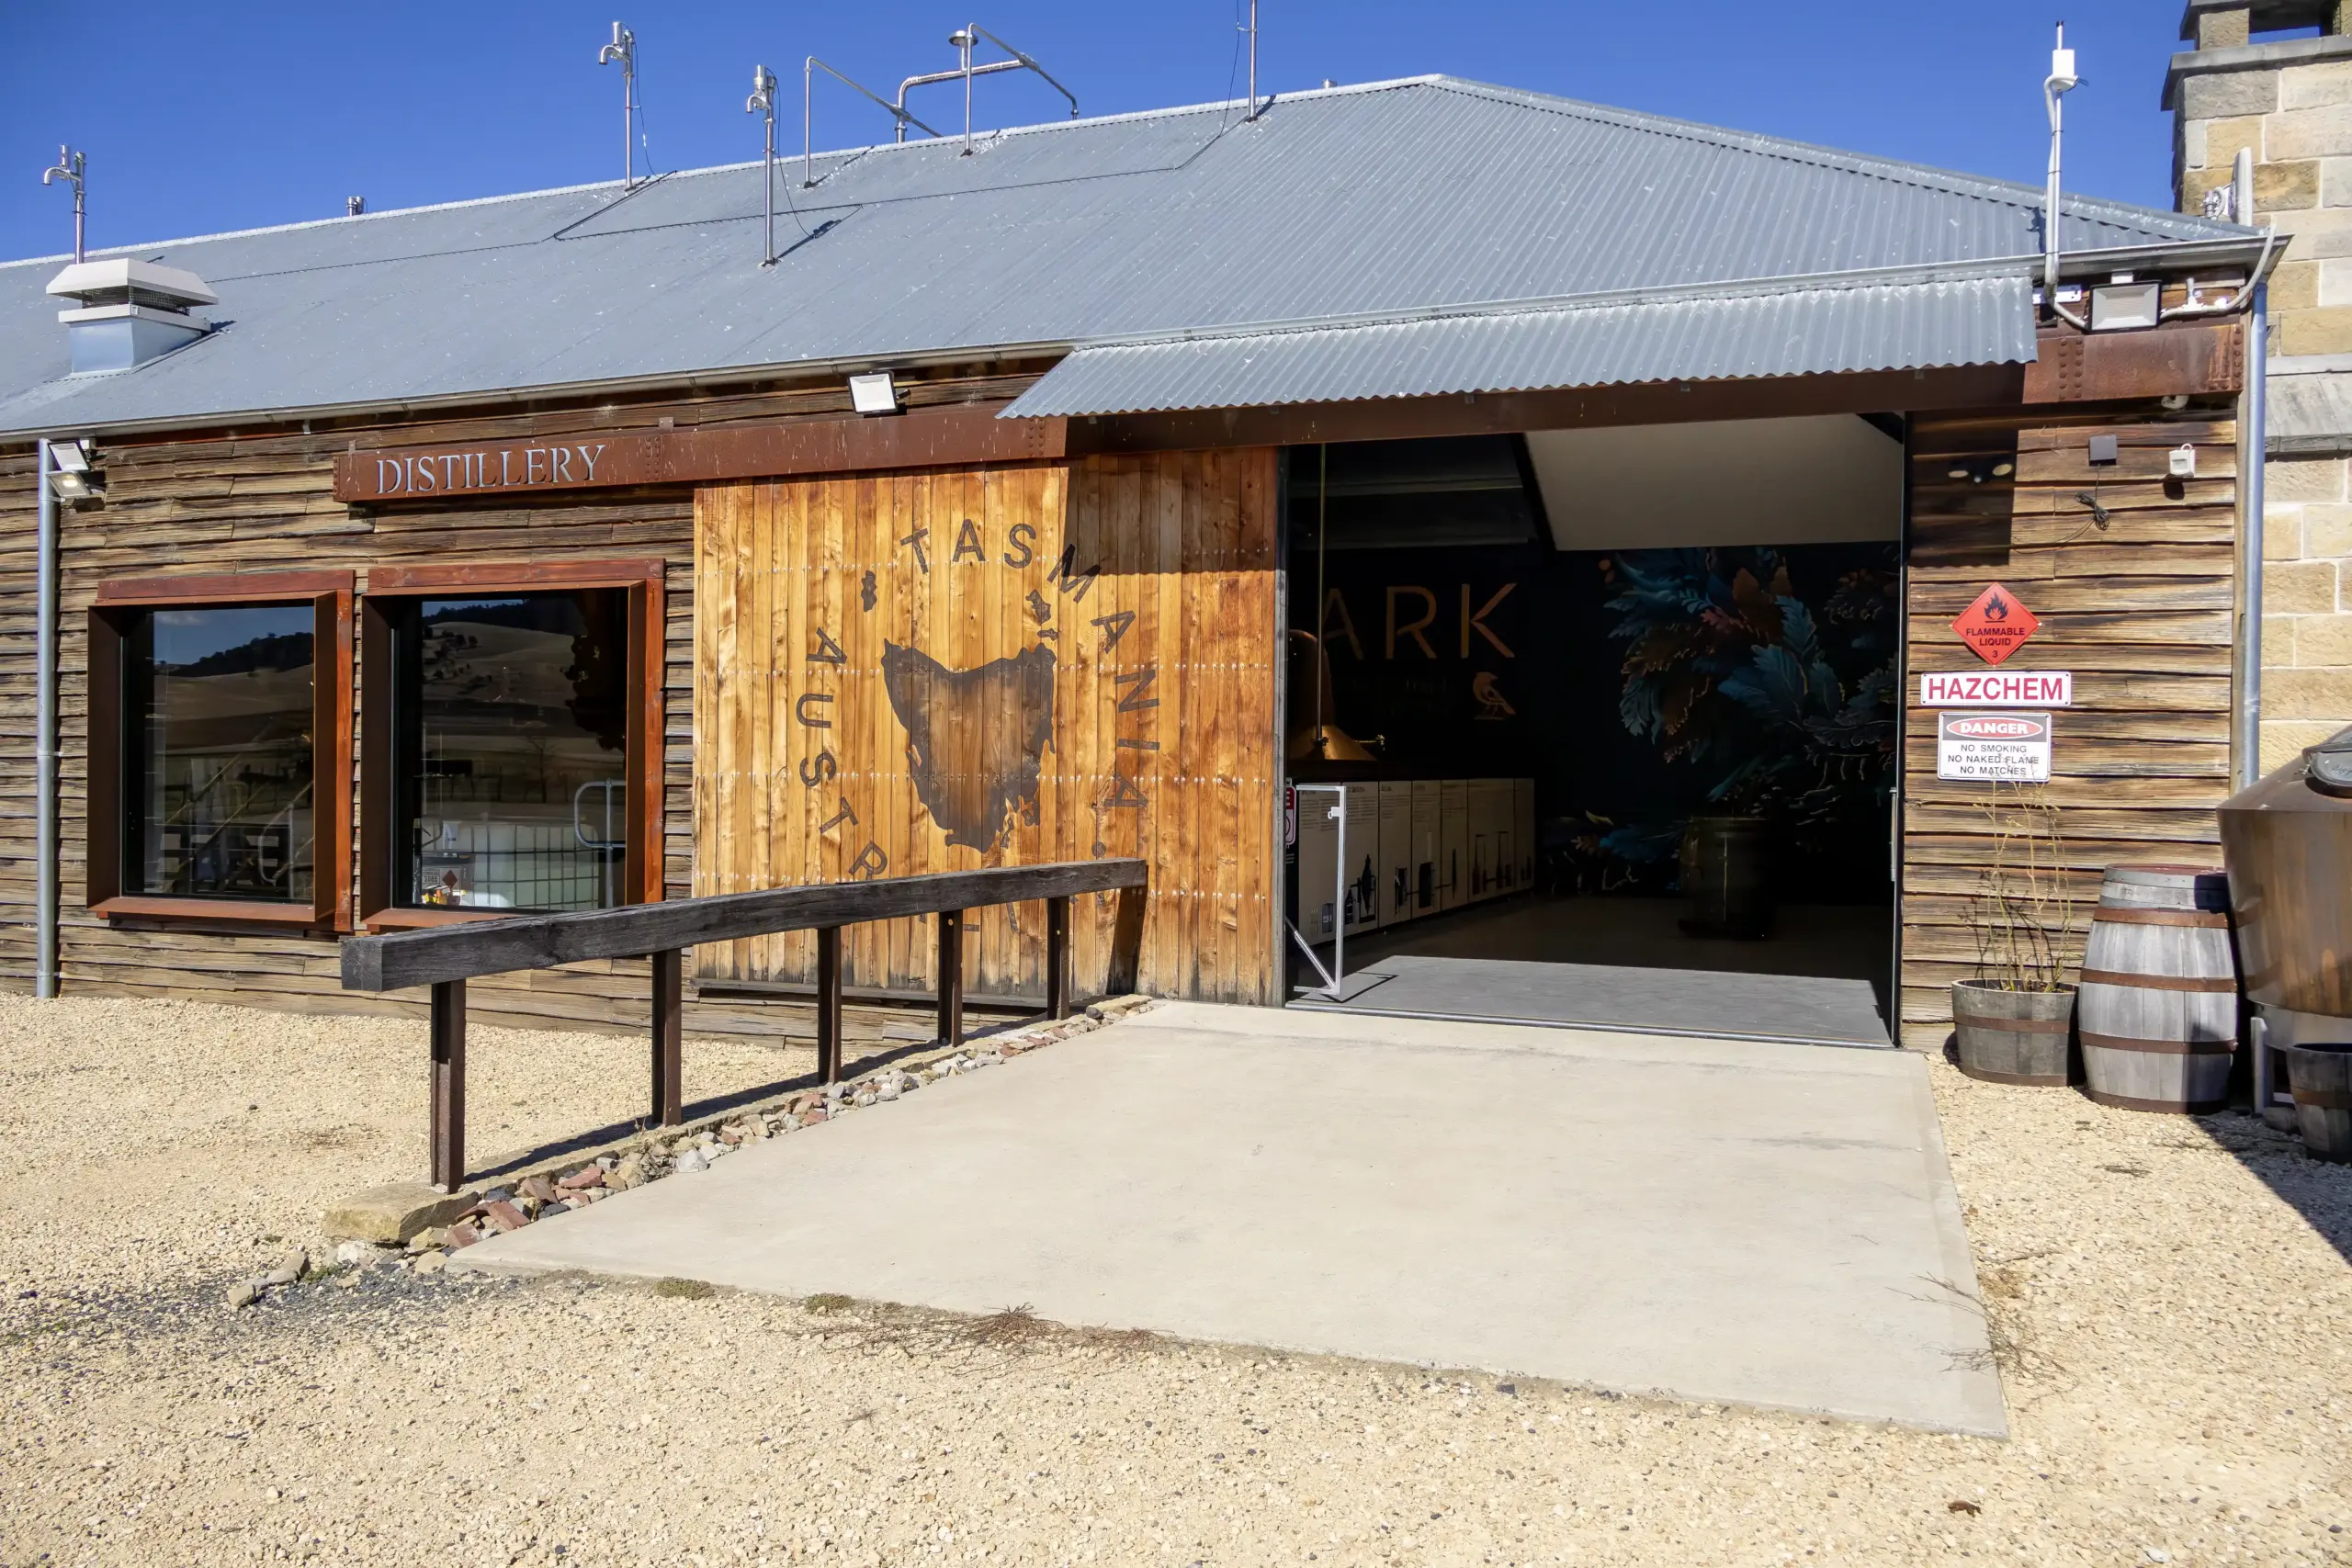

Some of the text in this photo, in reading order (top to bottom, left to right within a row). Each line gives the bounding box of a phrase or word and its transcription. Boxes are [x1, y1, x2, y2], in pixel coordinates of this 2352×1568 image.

[376, 445, 606, 494] DISTILLERY
[1965, 627, 2026, 637] FLAMMABLE
[1979, 637, 2011, 647] LIQUID
[1992, 649, 1998, 658] 3
[899, 518, 1160, 808] TASMANIA
[1928, 677, 2063, 700] HAZCHEM
[1960, 722, 2029, 735] DANGER
[1961, 744, 2027, 753] NO SMOKING
[1948, 754, 2040, 765] NO NAKED FLAME
[1960, 766, 2027, 775] NO MATCHES
